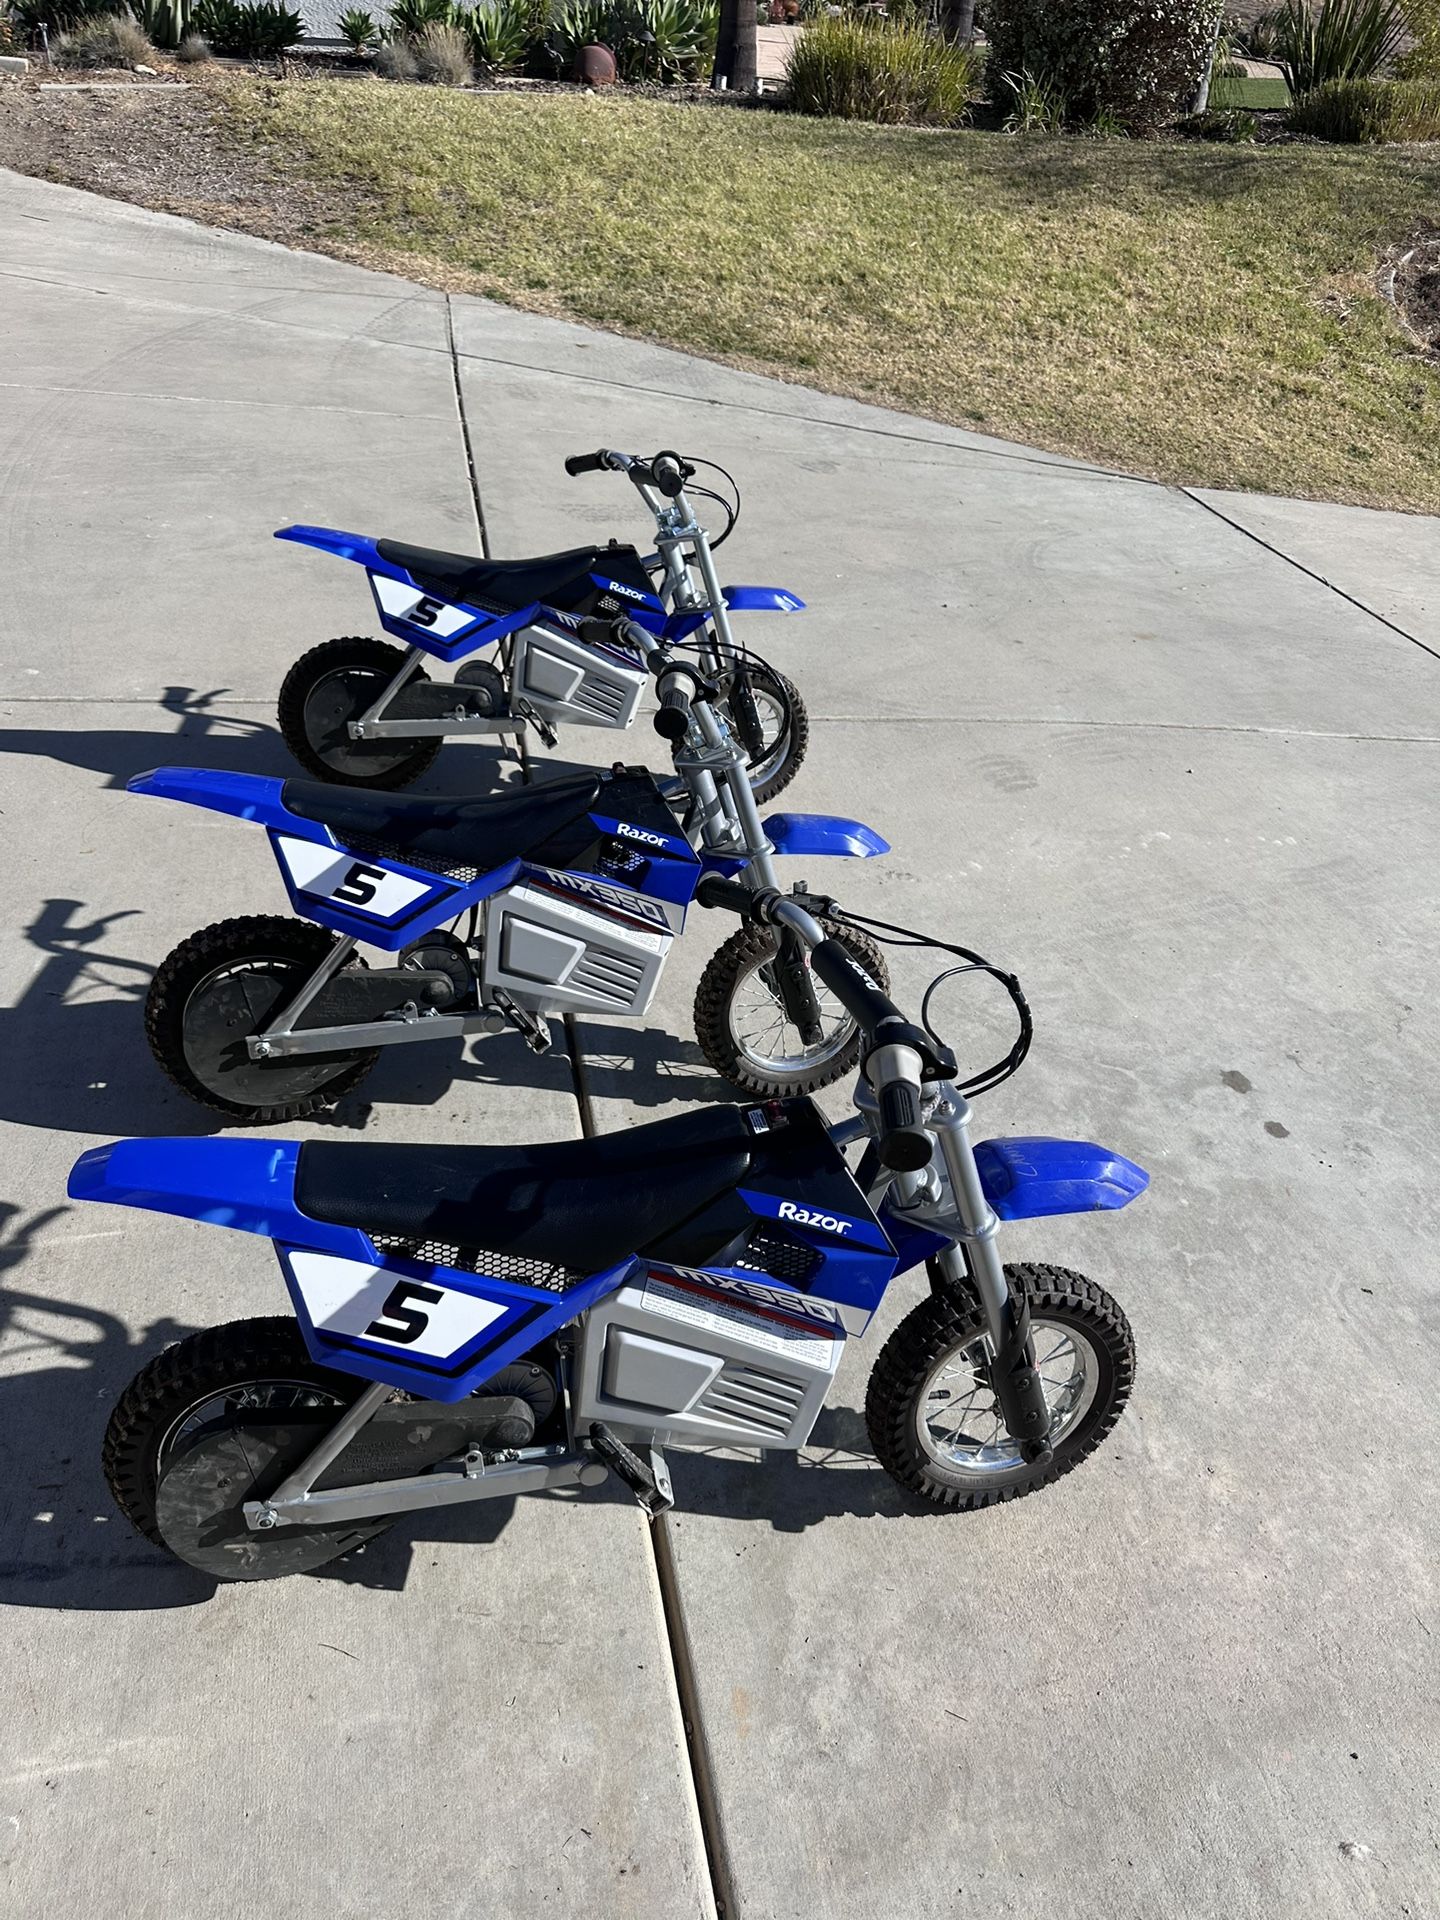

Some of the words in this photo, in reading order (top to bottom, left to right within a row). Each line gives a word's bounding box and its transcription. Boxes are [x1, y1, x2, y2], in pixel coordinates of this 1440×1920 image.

[609, 581, 647, 601] Razor
[616, 823, 669, 848] Razor
[778, 1201, 852, 1235] Razor
